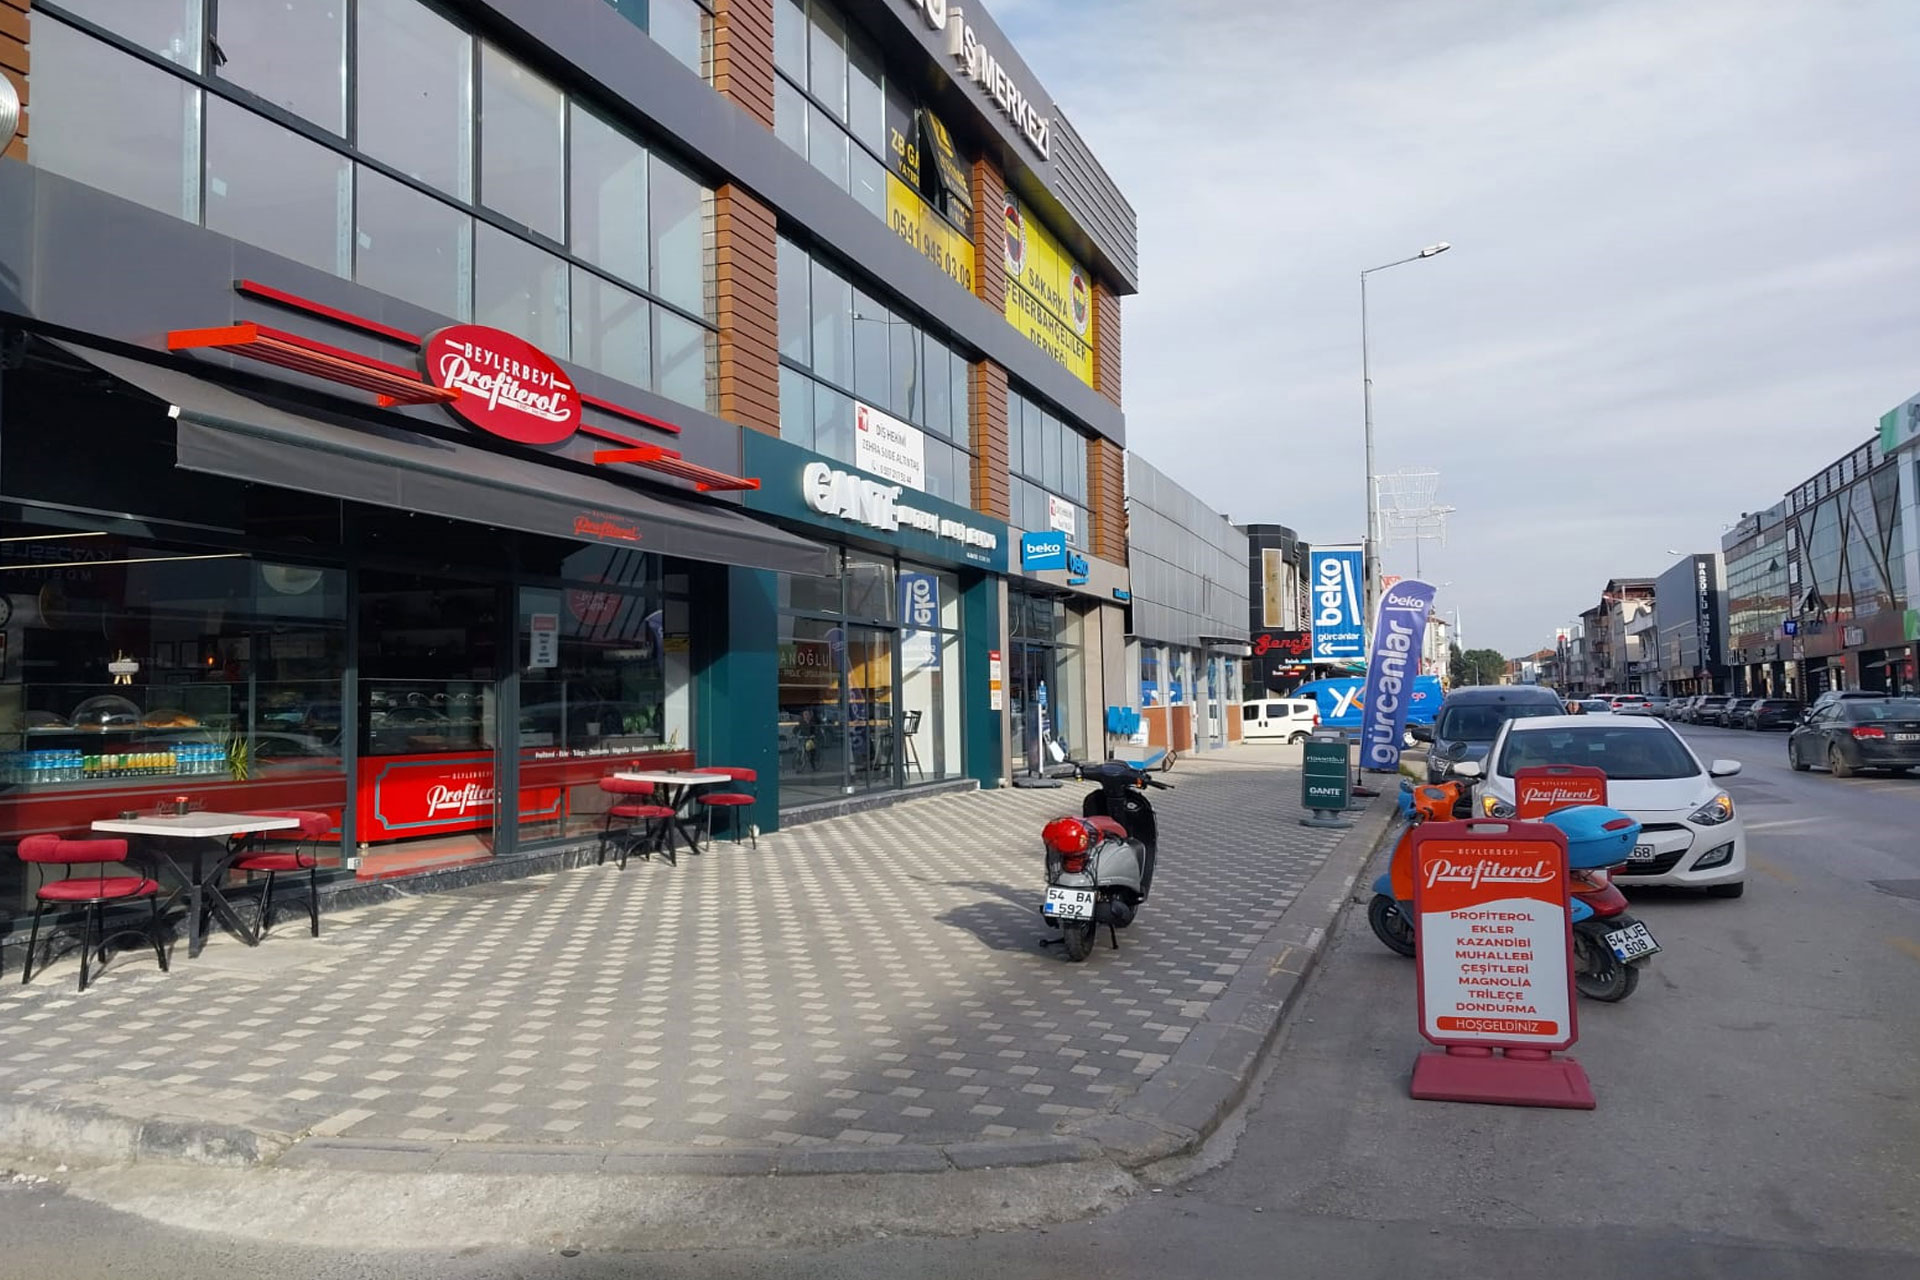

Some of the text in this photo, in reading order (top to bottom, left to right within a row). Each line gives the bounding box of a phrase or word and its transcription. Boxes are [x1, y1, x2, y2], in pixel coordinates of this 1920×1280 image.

[948, 6, 978, 77] İŞ
[973, 43, 1050, 161] MERKEZİ
[891, 127, 905, 157] ZB
[893, 208, 921, 249] 0541
[923, 237, 942, 267] 945
[945, 255, 957, 279] 03
[960, 263, 971, 291] 09
[1028, 267, 1068, 318] SAKARYA
[1005, 276, 1087, 363] FENERBAHÇELİLER
[464, 342, 554, 390] BEYLERBEYİ
[440, 353, 571, 422] Profiterol
[1027, 543, 1061, 553] beko
[1315, 558, 1342, 627] beko
[1388, 593, 1424, 608] beko
[1318, 632, 1360, 642] gürcanlar
[1371, 620, 1413, 763] gürcanlar
[1522, 788, 1600, 805] Profiterol
[1424, 858, 1556, 890] Profiterol
[1049, 890, 1092, 903] 54 BA
[1059, 904, 1084, 915] 592
[1451, 911, 1535, 921] PROFİTEROL
[1471, 925, 1514, 934] EKLER
[1608, 923, 1645, 946] 54 AJE
[1457, 938, 1531, 948] KAZANDİBİ
[1624, 942, 1648, 956] 608
[1456, 950, 1534, 961] MUHALLEBİ
[1461, 963, 1529, 975] ÇEŞİTLERİ
[1458, 976, 1532, 988] MAGNOLİA
[1468, 989, 1524, 1002] TRİLEÇE
[1456, 1002, 1537, 1014] DONDURMA
[1456, 1019, 1539, 1032] HOŞGELDİNİZ
